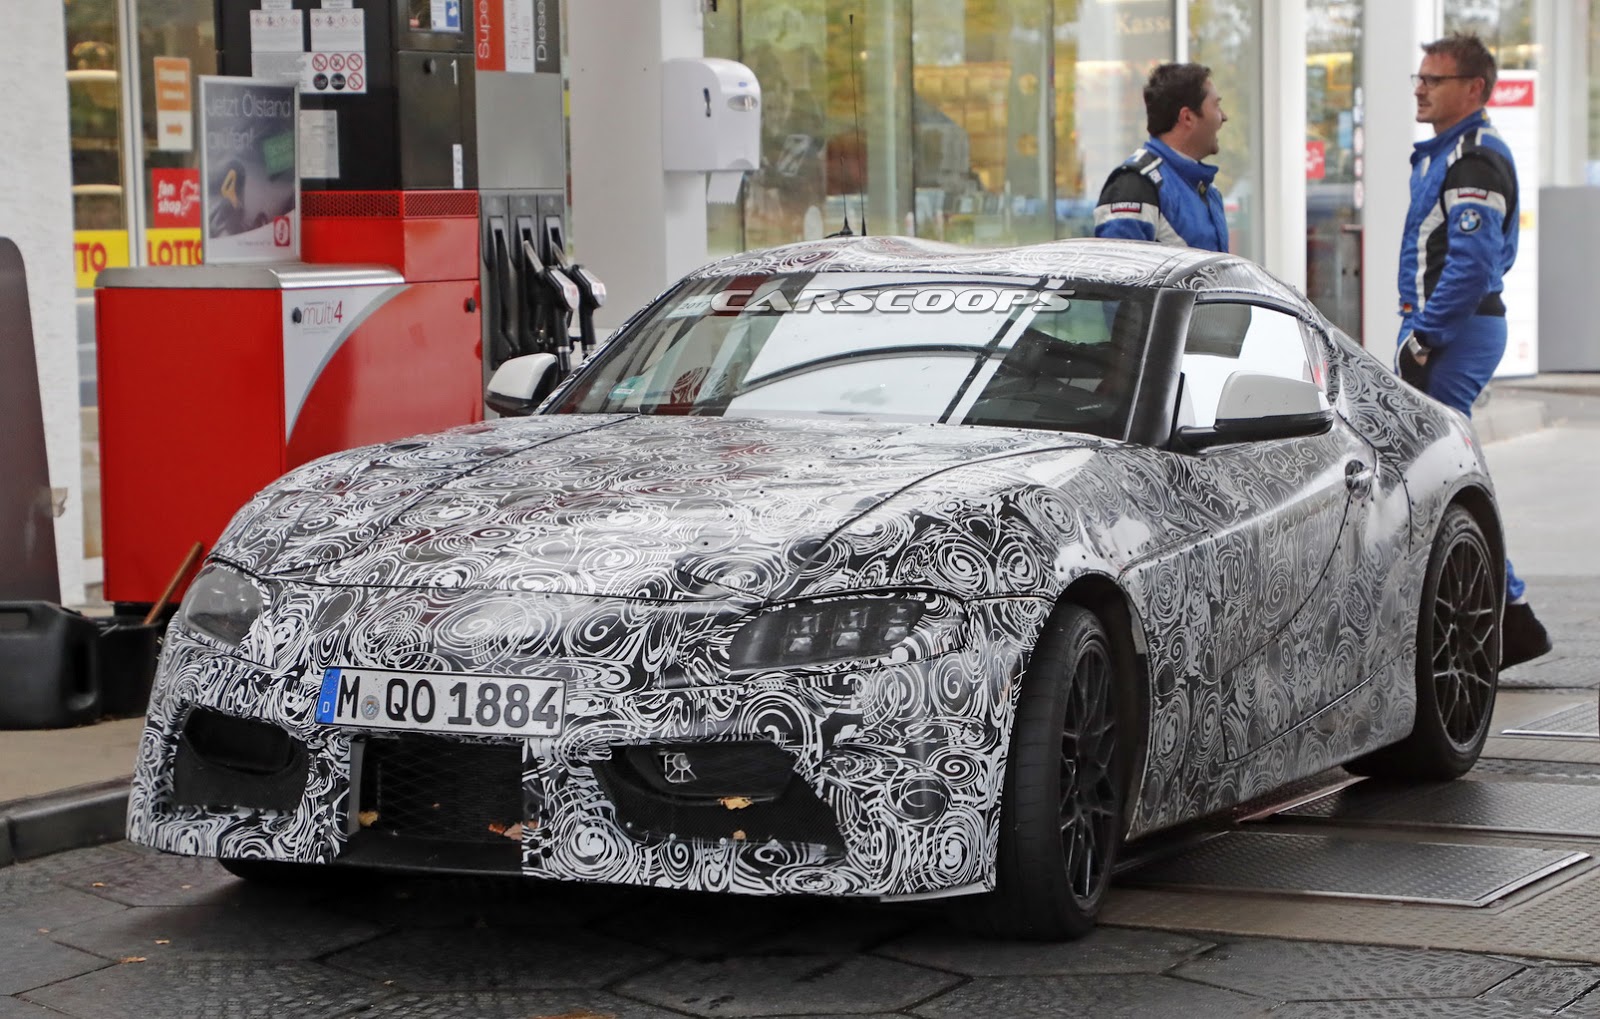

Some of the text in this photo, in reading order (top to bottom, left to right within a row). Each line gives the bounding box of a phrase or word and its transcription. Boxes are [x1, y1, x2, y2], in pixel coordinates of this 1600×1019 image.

[450, 59, 458, 85] 1
[207, 90, 291, 118] Jetzt Ölstand
[158, 198, 182, 217] shop
[322, 701, 331, 713] D
[336, 675, 559, 730] M QO 1884
